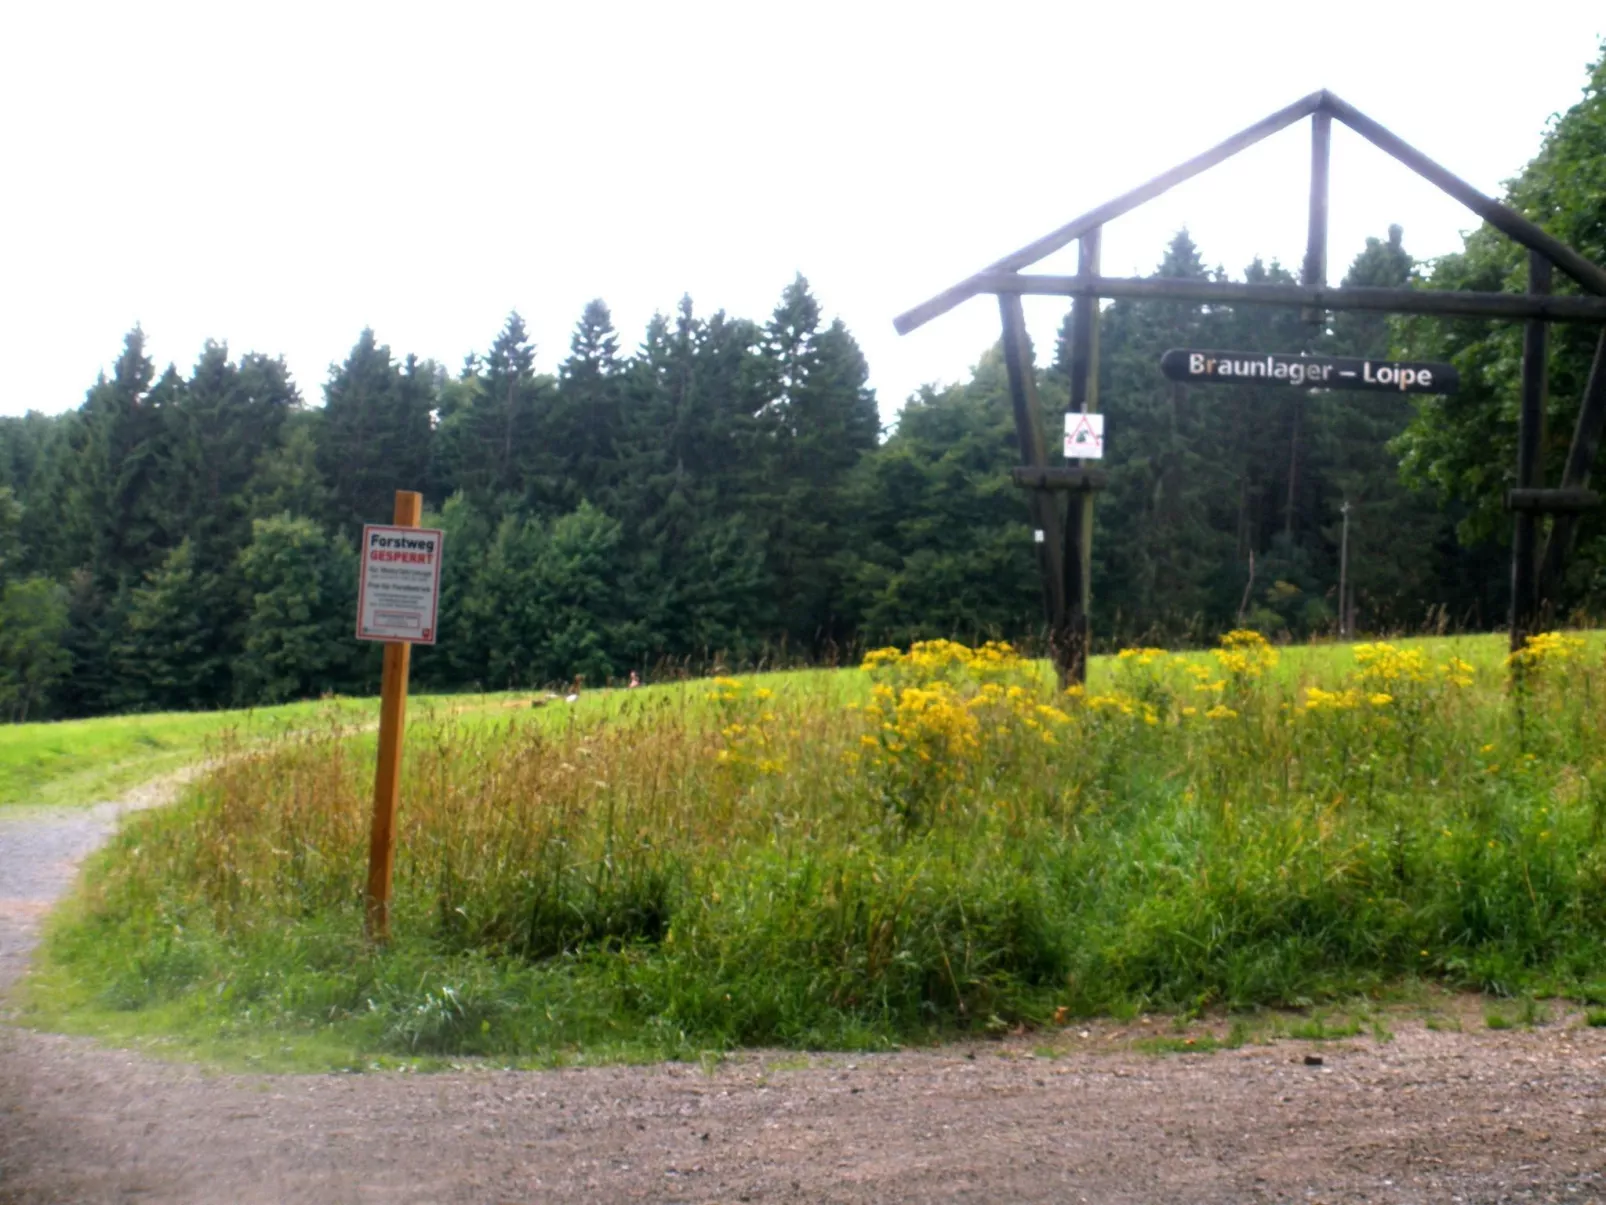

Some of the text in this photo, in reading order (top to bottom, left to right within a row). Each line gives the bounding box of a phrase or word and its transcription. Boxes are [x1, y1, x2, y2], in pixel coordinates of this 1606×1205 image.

[1188, 353, 1333, 384] Braunlager
[1363, 361, 1432, 390] Loipe
[371, 534, 433, 552] Forstweg
[371, 550, 433, 564] GESPERRT
